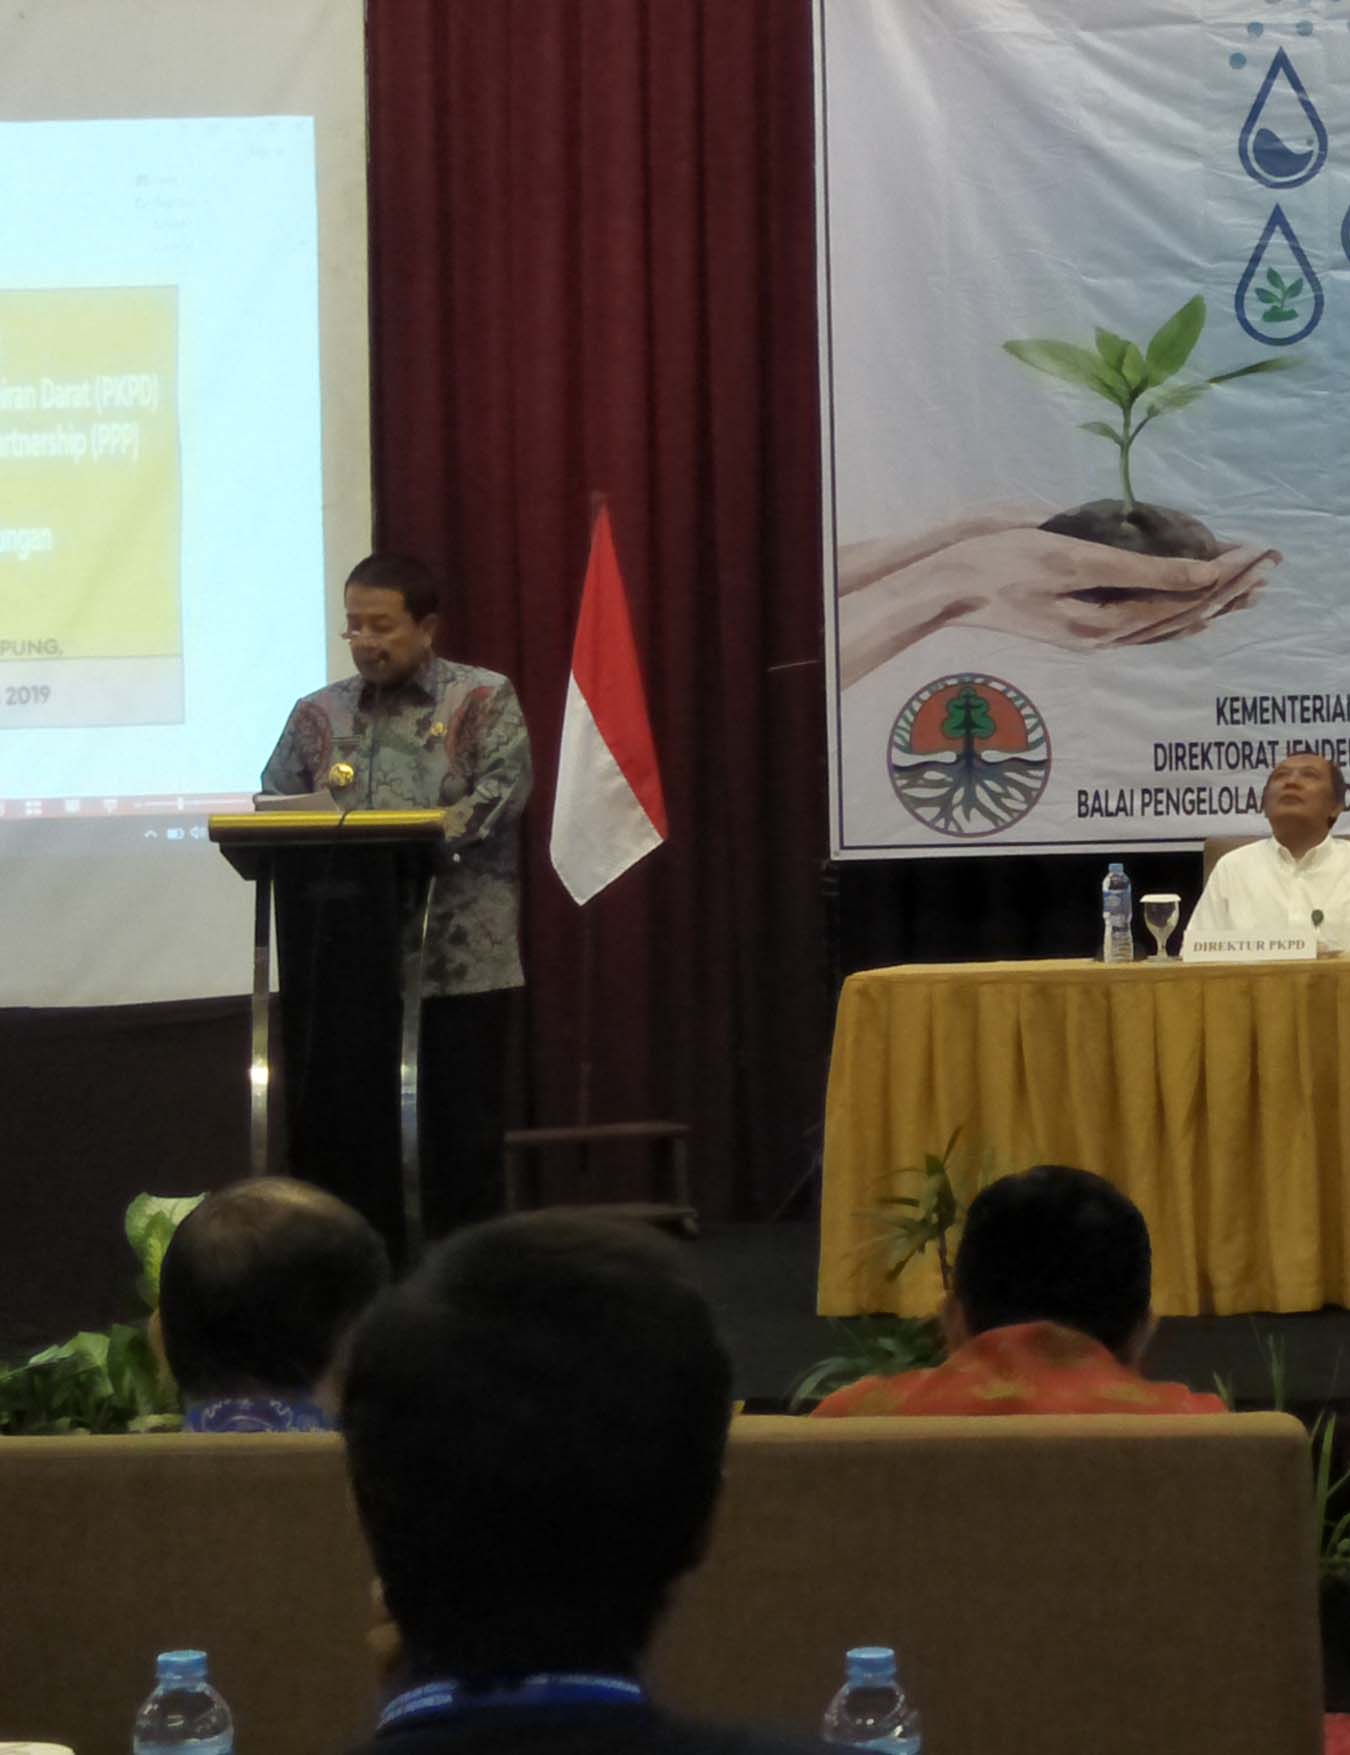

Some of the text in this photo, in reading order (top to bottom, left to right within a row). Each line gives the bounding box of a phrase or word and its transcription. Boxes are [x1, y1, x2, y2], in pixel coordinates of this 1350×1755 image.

[40, 376, 92, 409] Darat
[96, 372, 159, 416] (PKPD)
[91, 420, 140, 463] (PPP)
[5, 684, 51, 707] 2019
[1153, 740, 1279, 772] DIREKTORAT
[1077, 787, 1134, 819] BALAI
[1193, 939, 1306, 953] DIREKTUR PKPD
